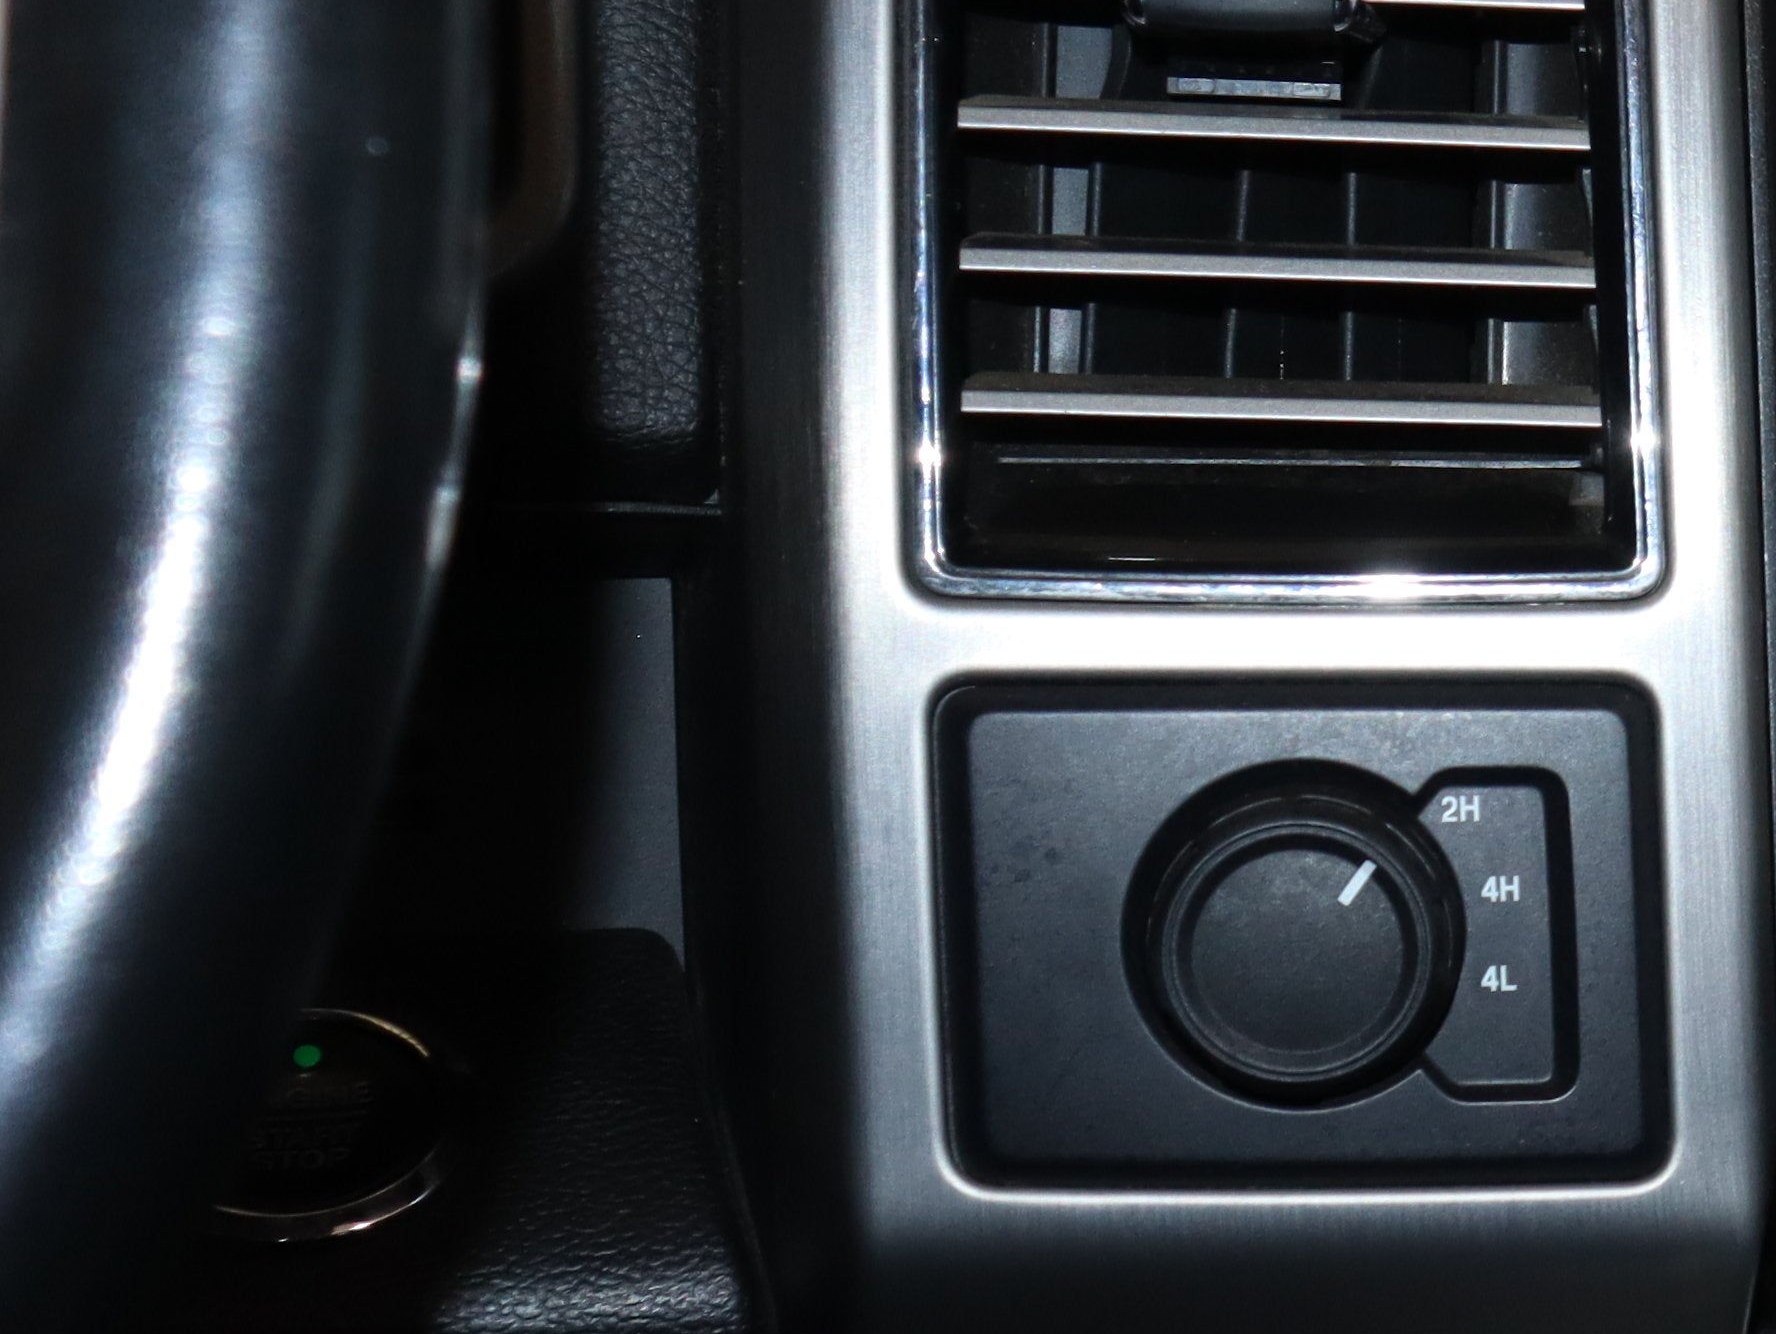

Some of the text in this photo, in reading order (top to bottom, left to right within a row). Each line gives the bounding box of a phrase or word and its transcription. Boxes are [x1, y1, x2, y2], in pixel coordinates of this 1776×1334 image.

[1441, 795, 1480, 823] 2H
[1481, 875, 1520, 903] 4H
[1480, 964, 1518, 992] 4L
